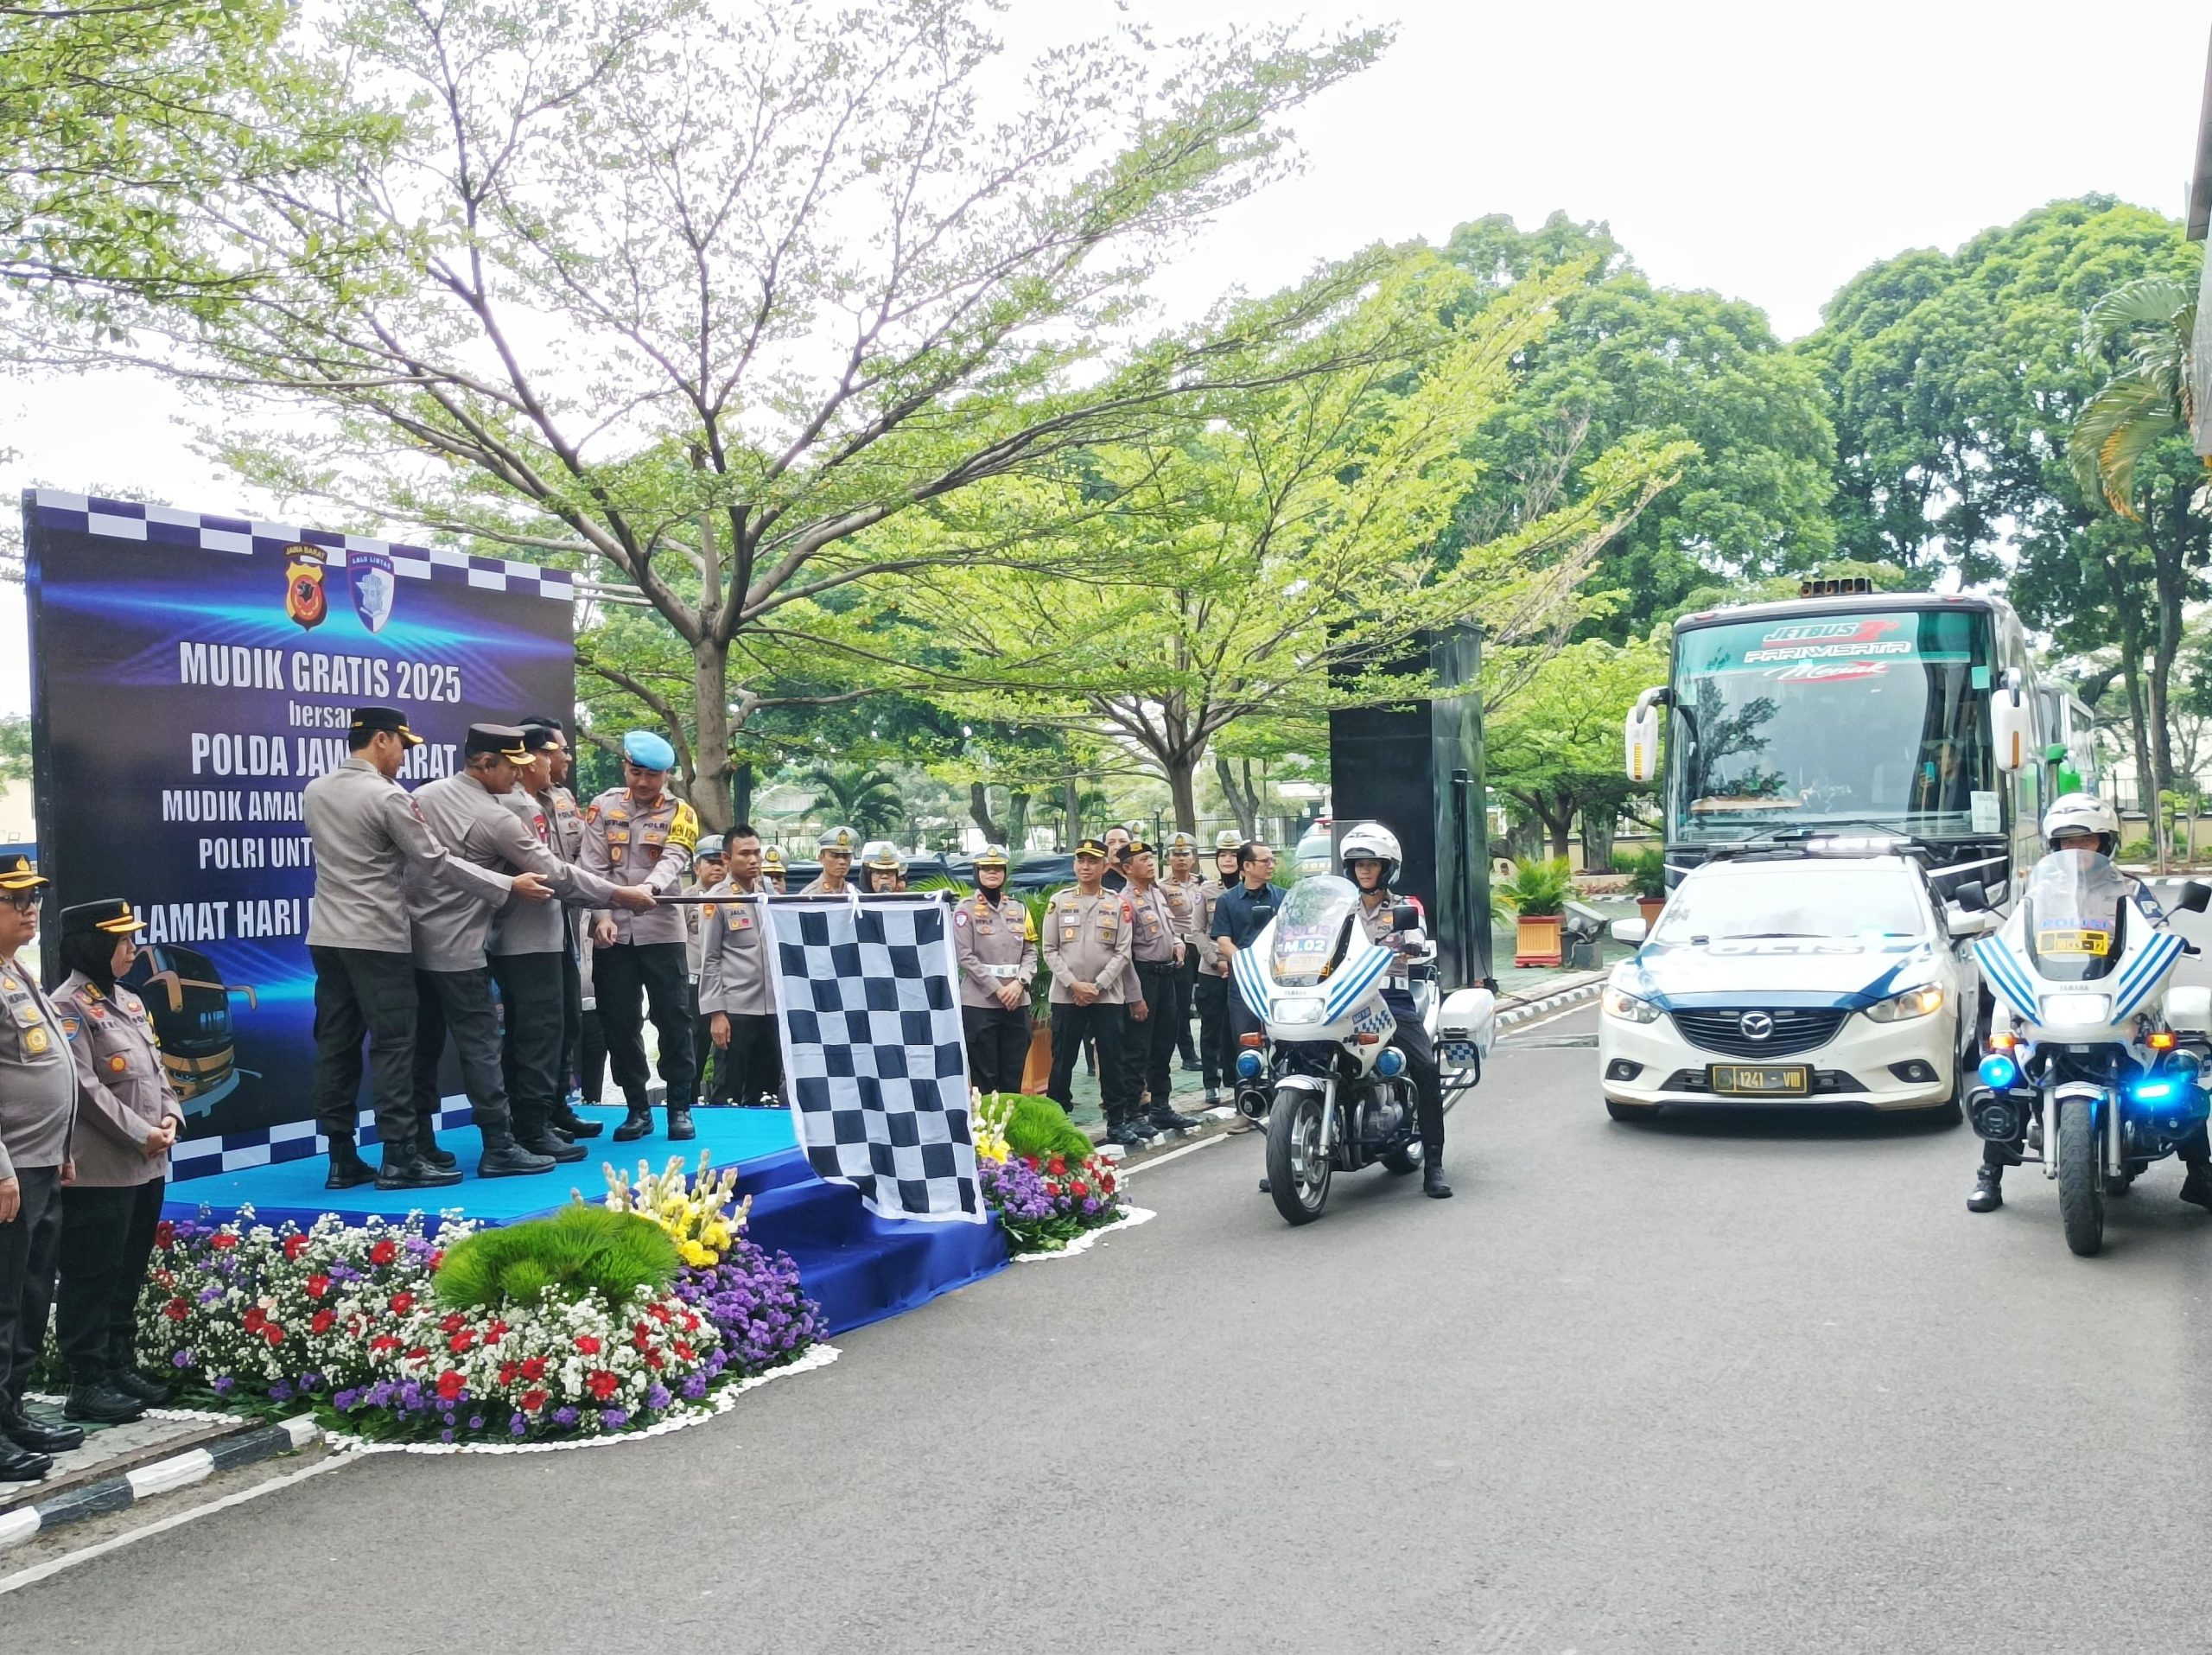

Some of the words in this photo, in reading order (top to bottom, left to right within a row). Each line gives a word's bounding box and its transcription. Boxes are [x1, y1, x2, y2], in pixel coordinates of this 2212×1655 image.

[286, 546, 302, 556] JAWA
[303, 546, 325, 560] BARAT
[370, 557, 391, 570] LINTAS
[1763, 622, 1859, 641] JETBUS
[1744, 641, 1911, 663] PARIWISATA
[180, 641, 284, 690] MUDIK
[292, 651, 390, 698] GRATIS
[396, 661, 461, 703] 2025
[191, 732, 289, 776] POLDA
[296, 737, 350, 777] JAW
[397, 743, 456, 780] ARAT
[162, 790, 243, 821] MUDIK
[642, 822, 668, 831] POLRI
[199, 837, 265, 869] POLRI
[270, 837, 317, 867] UNT
[133, 901, 229, 945] LAMAT
[237, 899, 301, 939] HARI
[2042, 918, 2109, 930] POLISI
[1740, 1072, 1763, 1087] 1241
